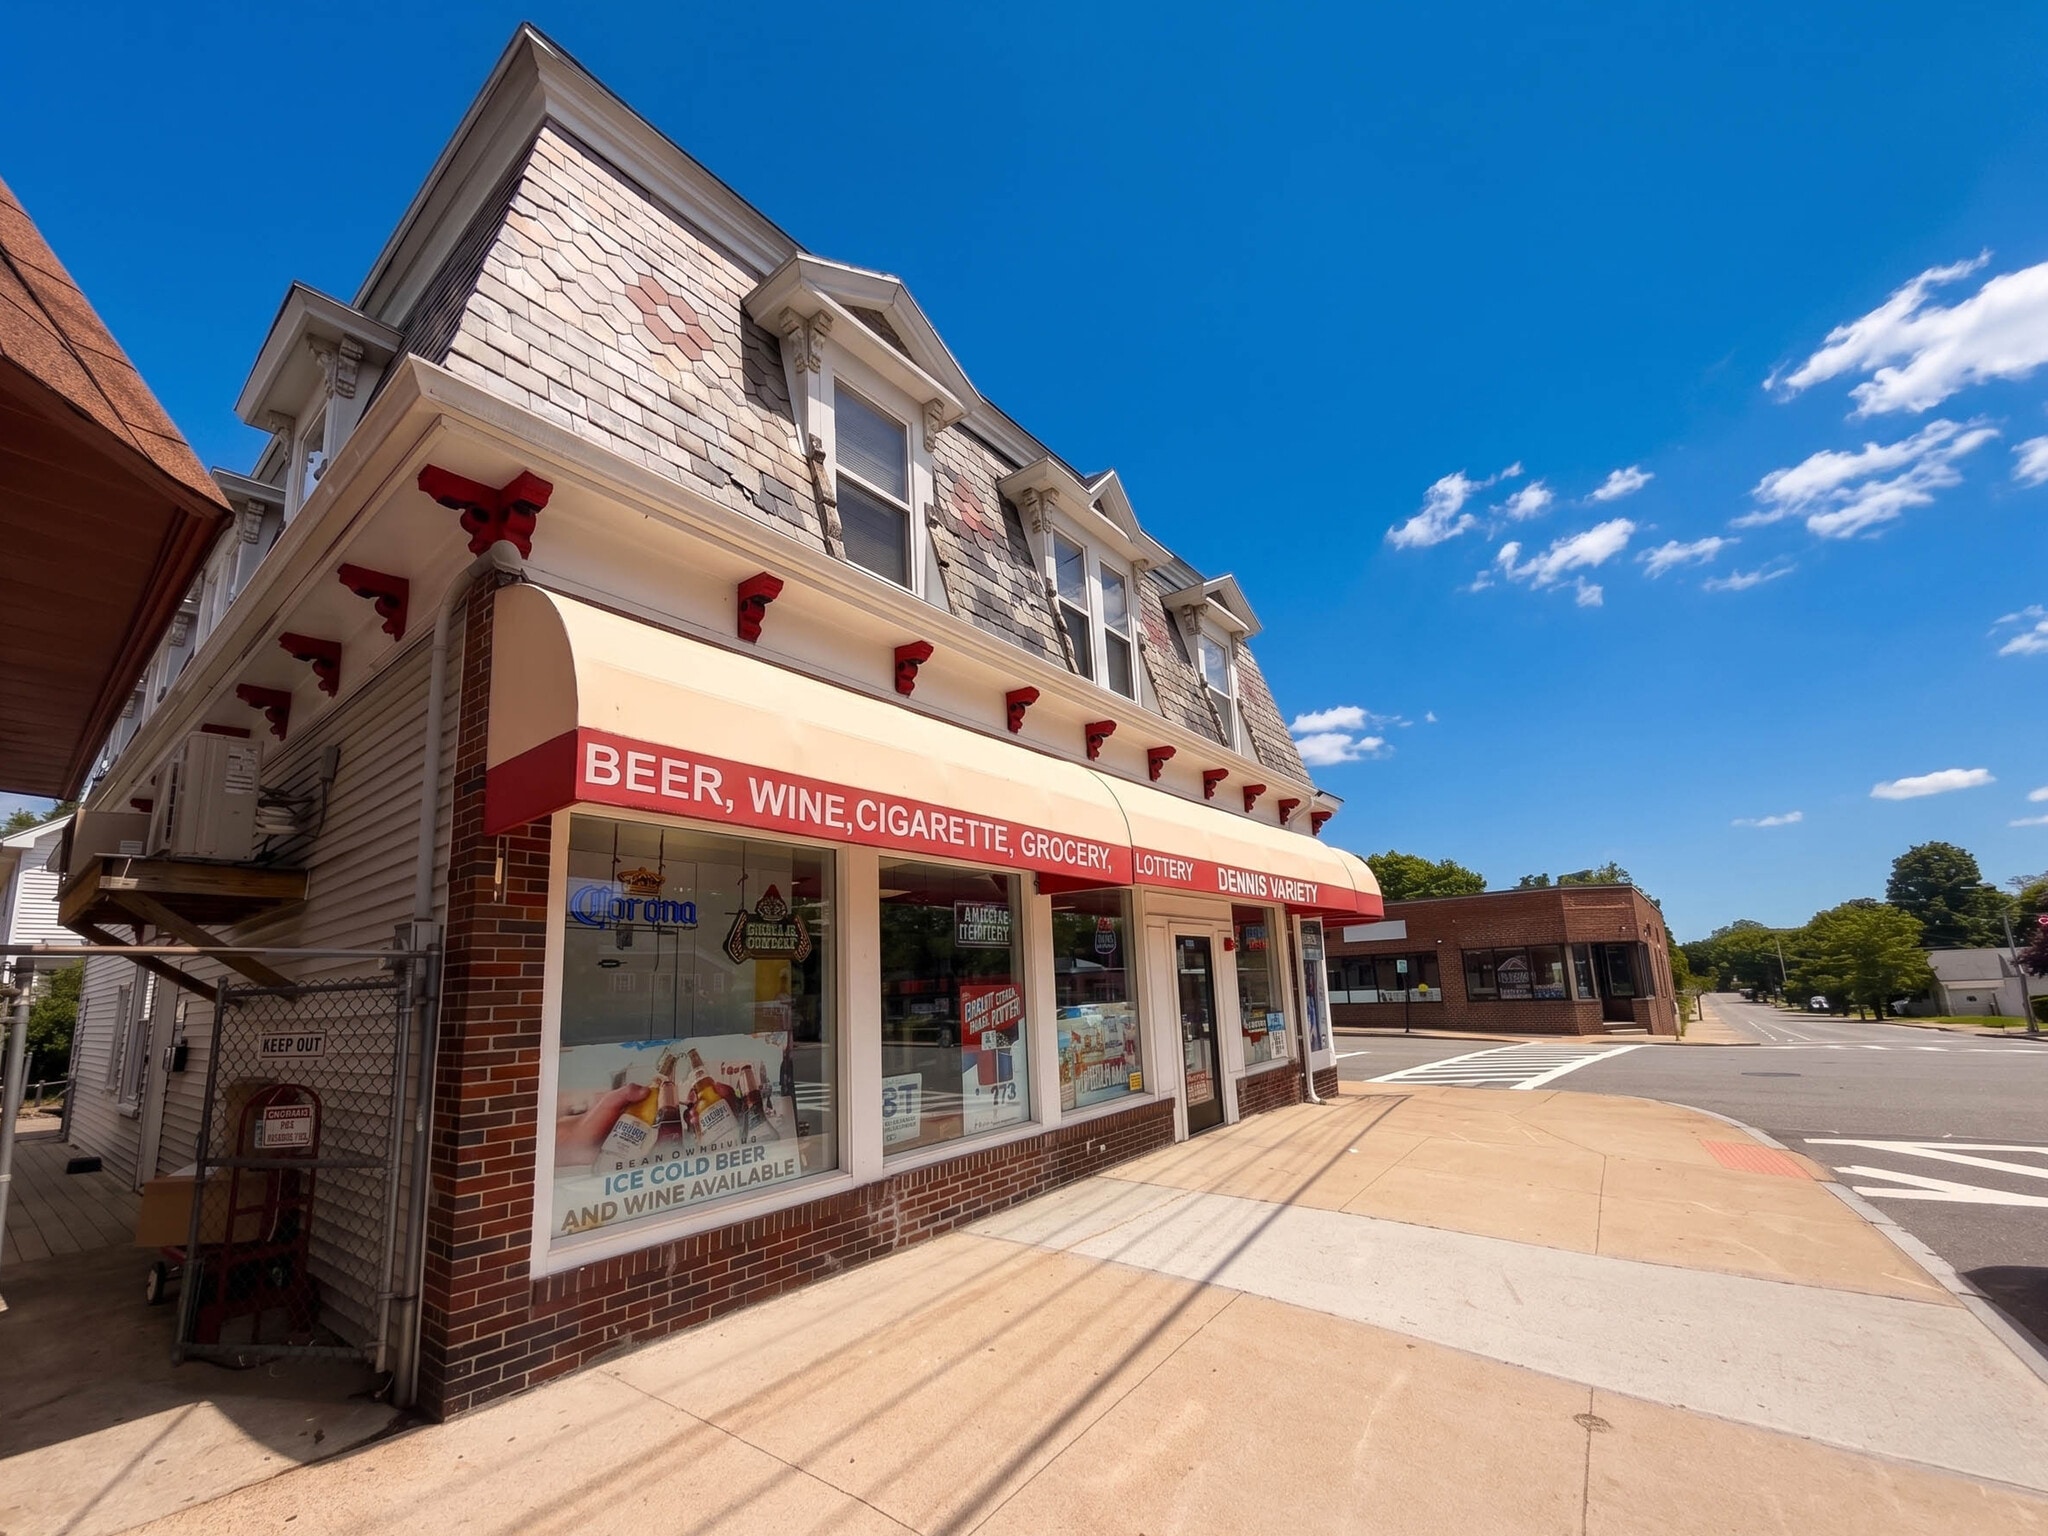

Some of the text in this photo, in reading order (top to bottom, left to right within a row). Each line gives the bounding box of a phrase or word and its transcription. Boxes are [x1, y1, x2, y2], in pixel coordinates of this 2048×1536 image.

[584, 742, 1318, 903] BEER, WINE, CIGARETTE, GROCERY, LOTTERY DENNIS VARIETY
[571, 884, 698, 929] Corona
[263, 1037, 322, 1053] KEEP OUT
[561, 1158, 795, 1231] AND WINE AVAILABLE
[604, 1145, 765, 1196] ICE COLD BEER
